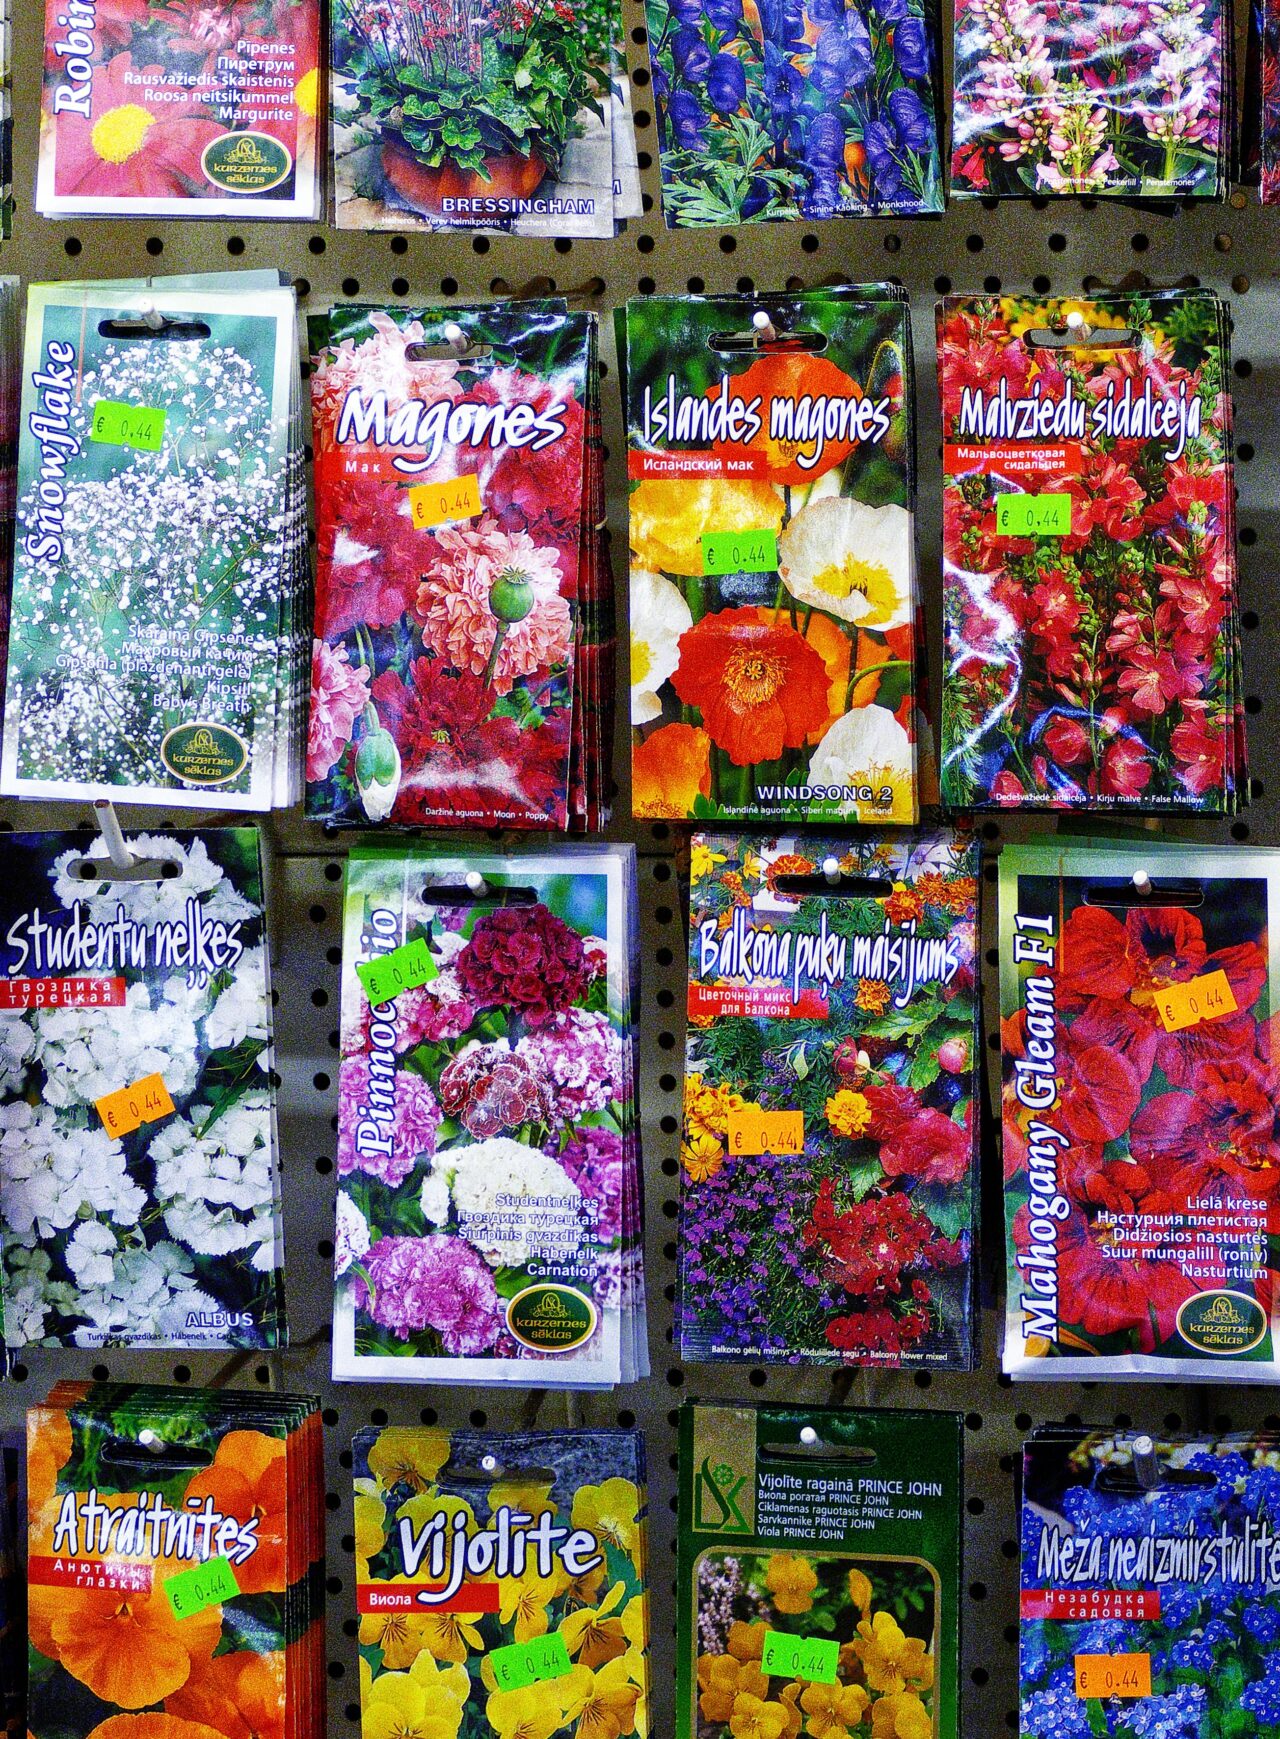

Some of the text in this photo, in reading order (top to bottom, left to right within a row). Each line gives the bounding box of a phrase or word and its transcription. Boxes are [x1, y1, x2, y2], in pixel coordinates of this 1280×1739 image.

[237, 40, 295, 55] Pīpenes
[217, 56, 295, 71] Пиретрум
[124, 71, 294, 89] Rausvažiedis skaistenis
[144, 89, 293, 105] Roosa neitsikummel
[219, 106, 292, 121] Margurite
[442, 198, 594, 214] BRESSINGHAM
[878, 200, 925, 210] Monkshood
[642, 373, 891, 469] Islandes magones
[960, 377, 1201, 463] Malvziedu sidalceja
[337, 389, 566, 474] Magones
[25, 340, 81, 562] Snowflake
[957, 448, 1066, 460] Мальвоцветковая
[346, 460, 380, 472] Мак
[643, 458, 754, 472] Исландский мак
[1004, 459, 1066, 470] сидальцея
[205, 647, 252, 661] качим
[206, 681, 251, 696] Kipsill
[153, 695, 250, 713] Baby's Breath
[757, 785, 893, 803] WINDSONG 2
[1151, 794, 1203, 804] False Mallow
[456, 809, 549, 822] aguona Poppy
[760, 806, 790, 816] aguona
[3, 899, 147, 975] Studentu
[699, 906, 961, 1010] Balkona puķu maisījums
[9, 979, 111, 993] Гвоздика
[9, 991, 112, 1006] турецкая
[699, 989, 790, 1002] Цветочный микс
[721, 1003, 789, 1016] для Балкона
[1013, 914, 1070, 1342] Mahogany Gleam F1
[495, 1193, 599, 1211] Studentneļķes
[1187, 1196, 1267, 1211] Lielā krese
[457, 1209, 599, 1228] Гвоздика турецкая
[1097, 1211, 1267, 1228] Настурция плетистая
[525, 1228, 598, 1244] gvazdikas
[1113, 1228, 1192, 1243] Didžiosios
[530, 1244, 598, 1259] Habenelk
[1102, 1244, 1268, 1263] Suur mungalill (roniv)
[527, 1261, 598, 1277] Carnation
[1181, 1263, 1267, 1280] Nasturtium
[185, 1312, 253, 1329] ALBUS
[1190, 1323, 1255, 1335] kurzemes
[758, 1473, 942, 1497] Vijolīte PRINCE JOHN
[865, 1494, 889, 1505] JOHN
[862, 1508, 922, 1520] PRINCE JOHN
[53, 1488, 260, 1565] Atraitnītes
[814, 1516, 875, 1531] PRINCE JOHN
[758, 1526, 844, 1540] Viola PRINCE JOHN
[398, 1506, 603, 1605] Vijolīte
[369, 1592, 412, 1606] Виола
[1045, 1592, 1144, 1606] Незабудка
[1070, 1606, 1144, 1618] садовая
